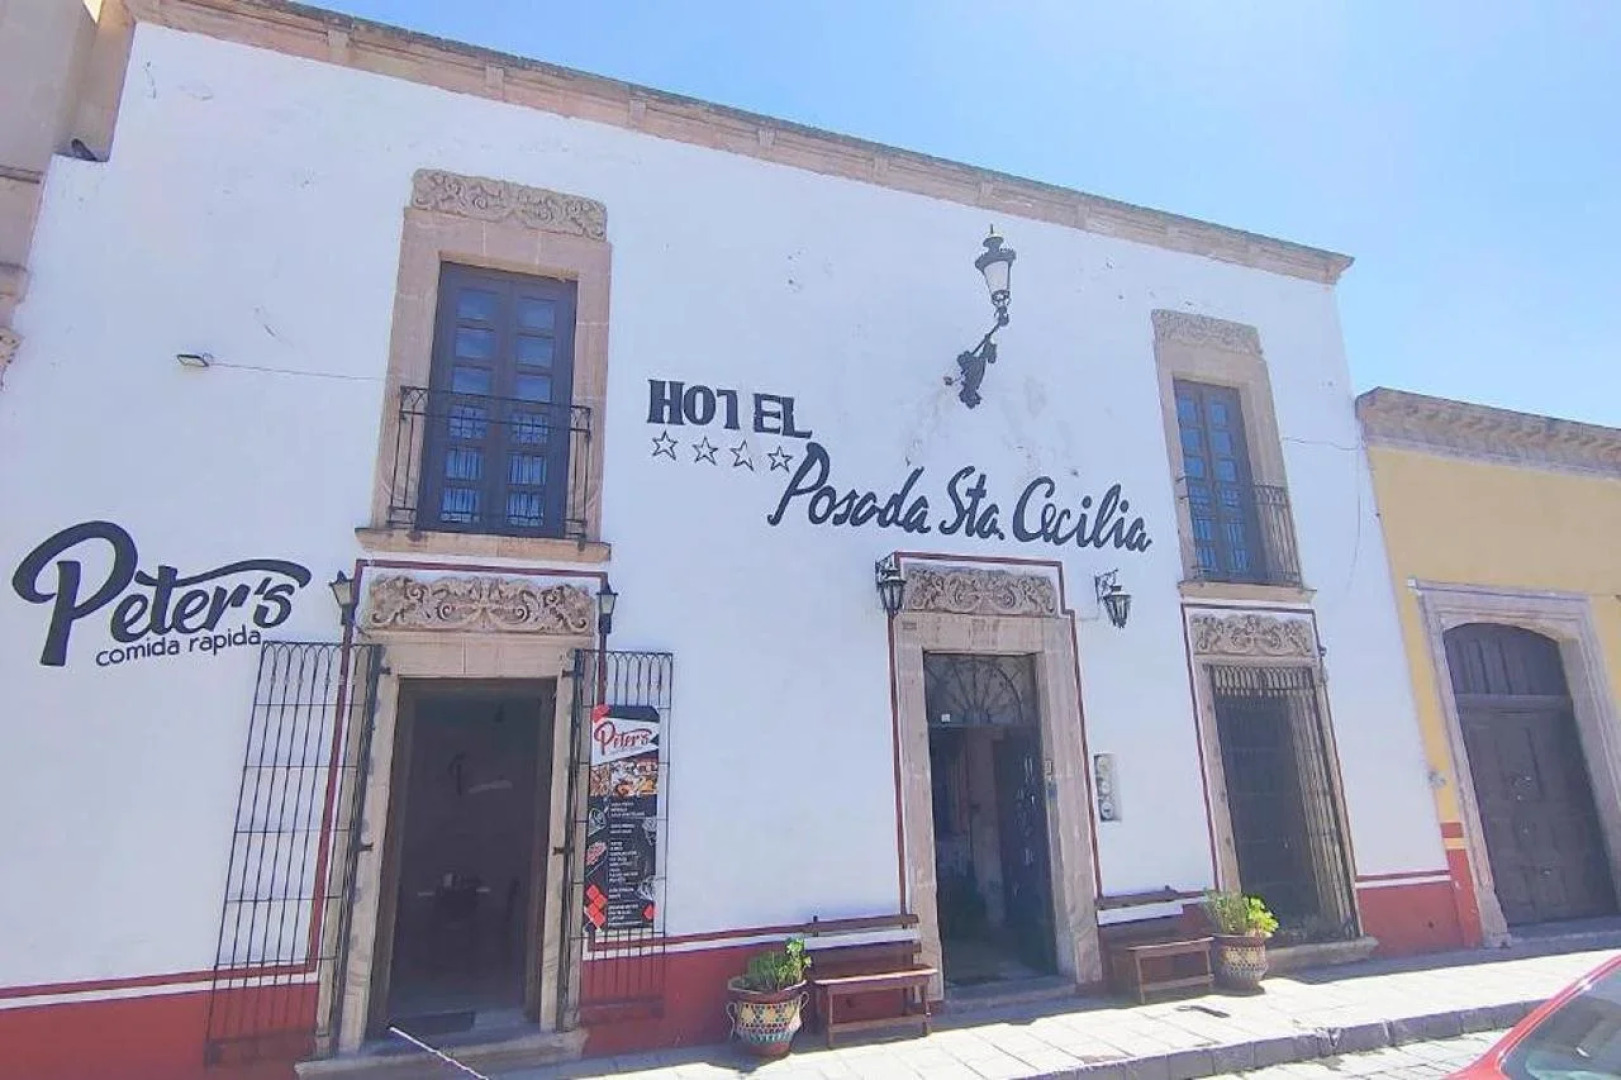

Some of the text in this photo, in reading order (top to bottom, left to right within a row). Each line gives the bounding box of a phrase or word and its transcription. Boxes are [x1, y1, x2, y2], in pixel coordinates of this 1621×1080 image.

[767, 442, 1153, 553] Posada Sta. Cecilia
[12, 520, 311, 667] Peter's
[95, 624, 262, 667] comida rapida
